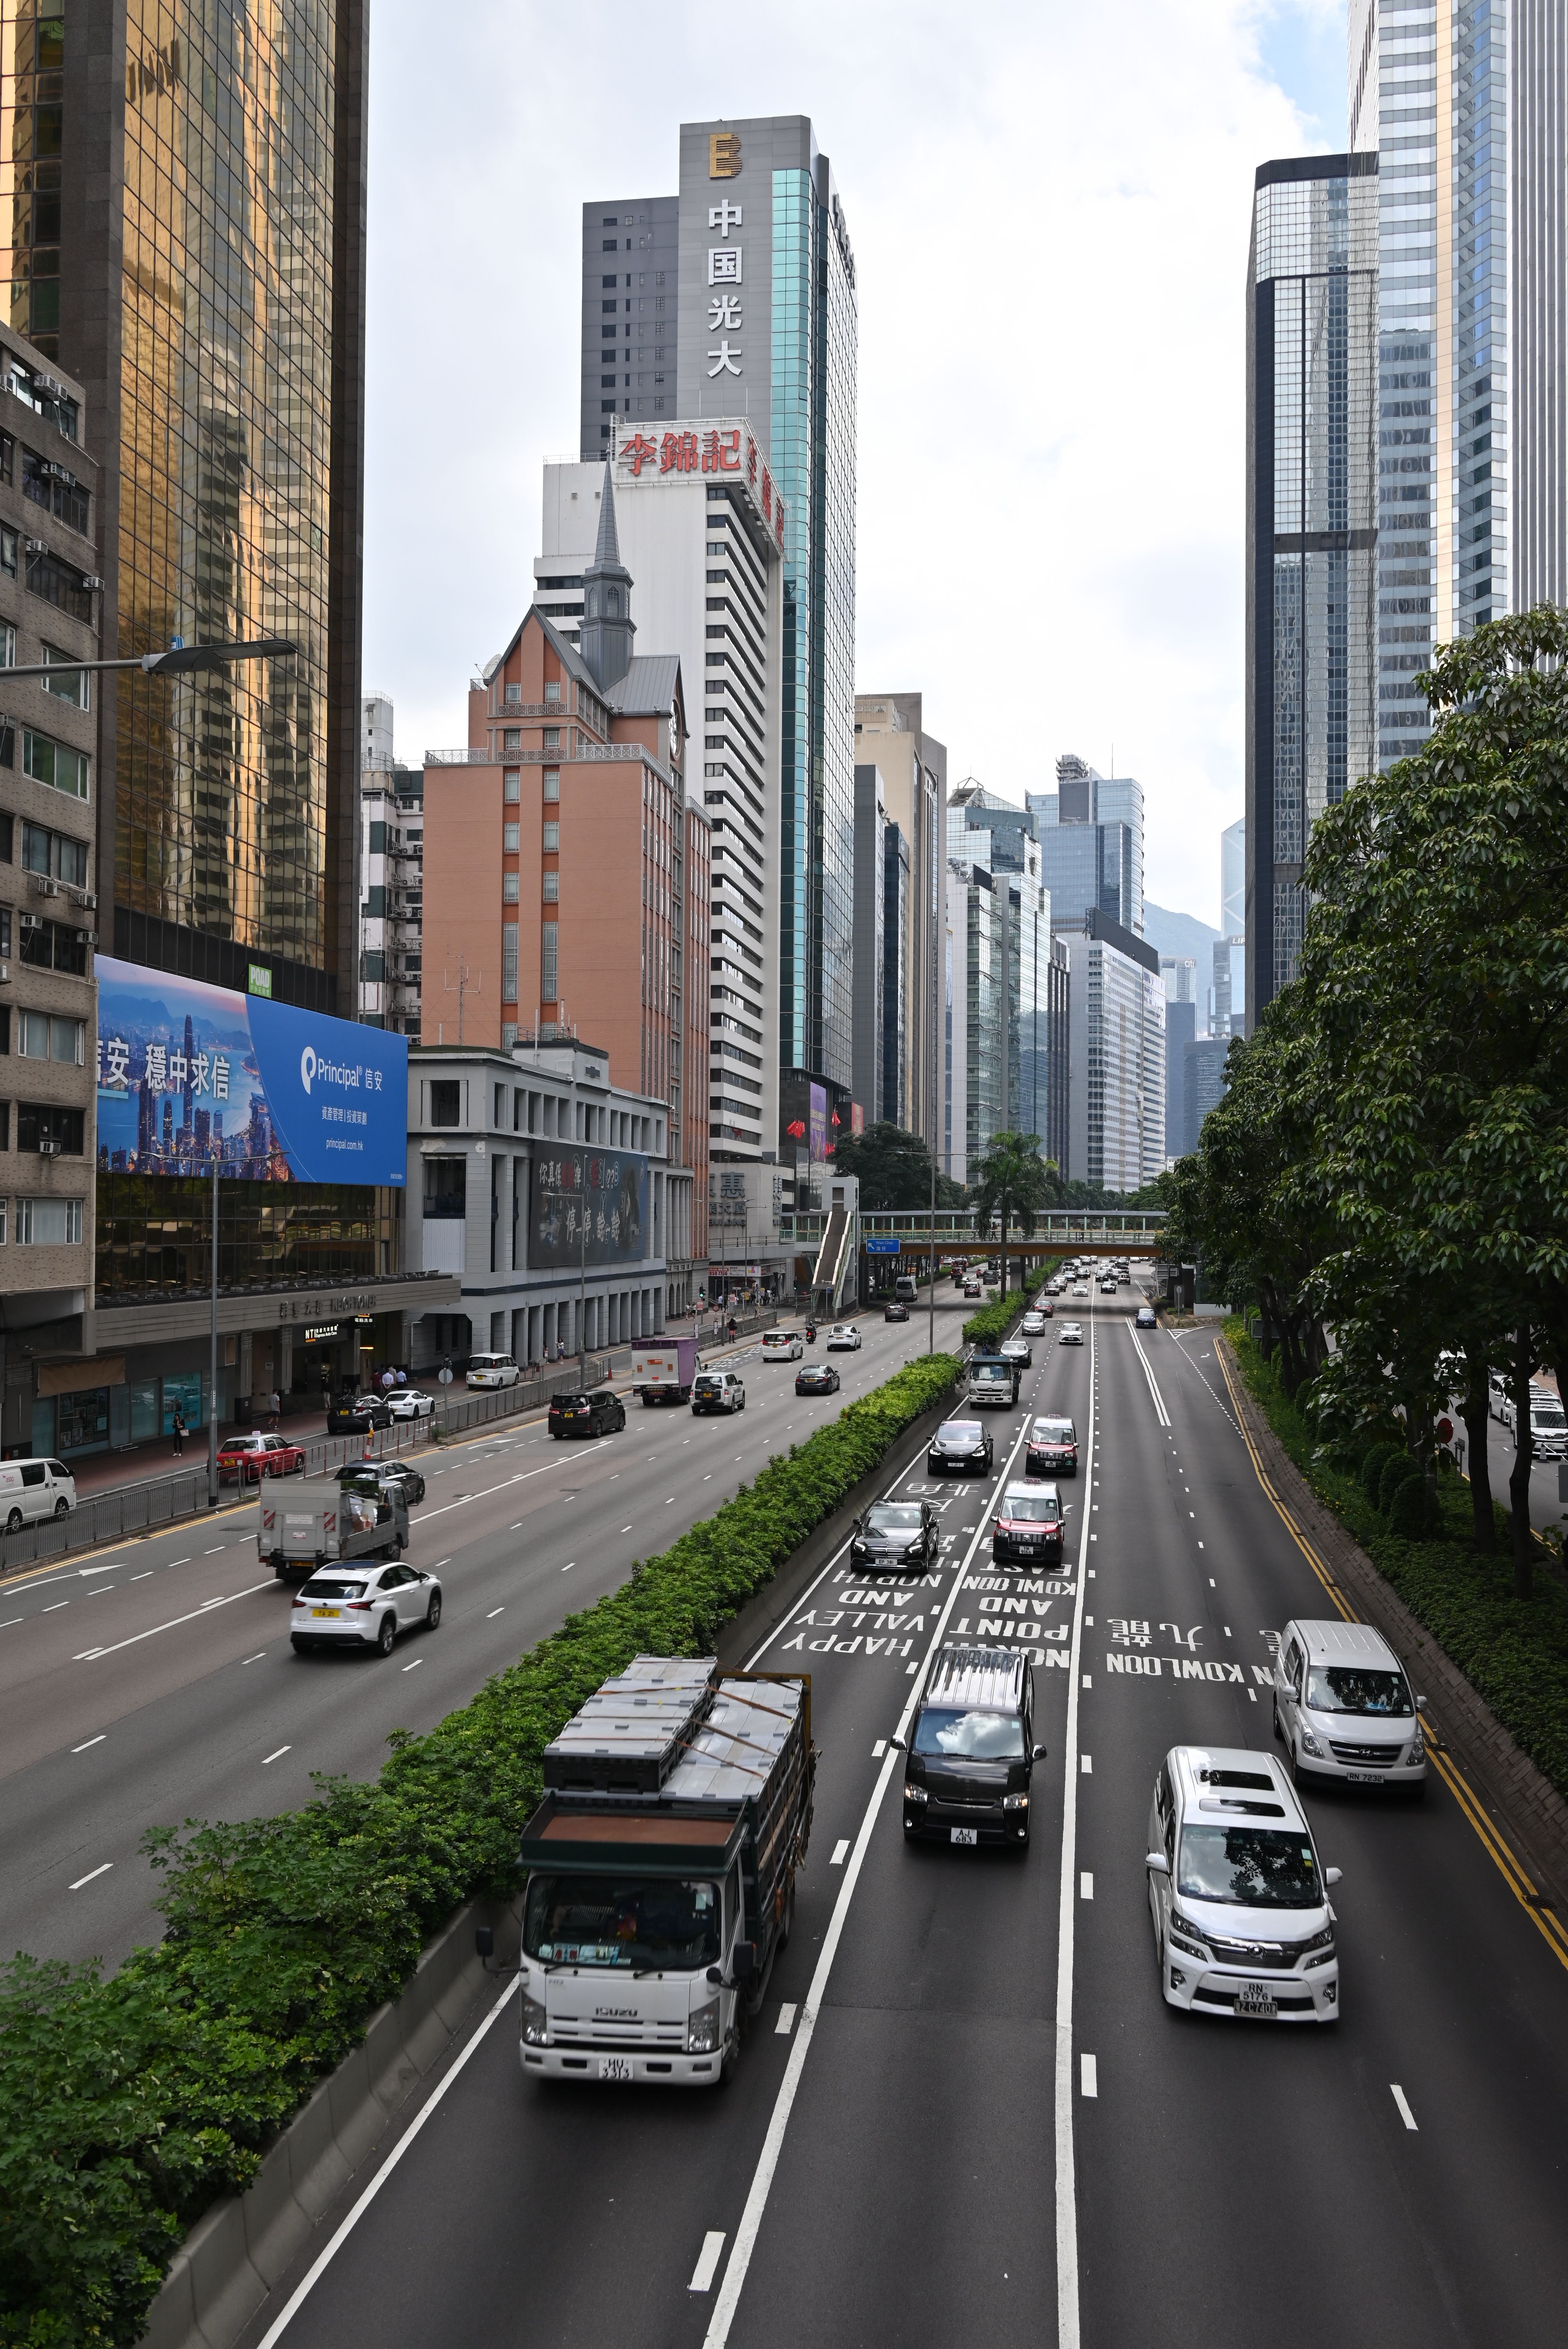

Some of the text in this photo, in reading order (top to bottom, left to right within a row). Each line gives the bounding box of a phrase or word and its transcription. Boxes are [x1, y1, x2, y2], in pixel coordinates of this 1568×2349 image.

[707, 199, 742, 378] 中国光大
[618, 429, 741, 476] 李錦記
[251, 966, 270, 988] POAD
[144, 1043, 230, 1100] 穩中求信
[365, 1068, 382, 1091] 信安
[326, 1137, 363, 1151] principal.com.hk
[332, 1296, 352, 1311] NEICH
[353, 1294, 376, 1308] TOWER
[832, 1570, 943, 1588] NORTH
[961, 1576, 1077, 1595] KOWLOON
[838, 1590, 914, 1606] AND
[979, 1597, 1053, 1615] AND
[793, 1610, 924, 1631] VALLEY
[949, 1618, 1069, 1641] POINT
[782, 1633, 914, 1657] HAPPY
[1107, 1619, 1203, 1652] 九龍
[1107, 1653, 1245, 1683] KOWLOON
[956, 1836, 972, 1844] 683
[1243, 1991, 1269, 2001] 5176
[1249, 1983, 1263, 1992] RN
[596, 2007, 638, 2017] ISUZU
[602, 2066, 629, 2078] 3313
